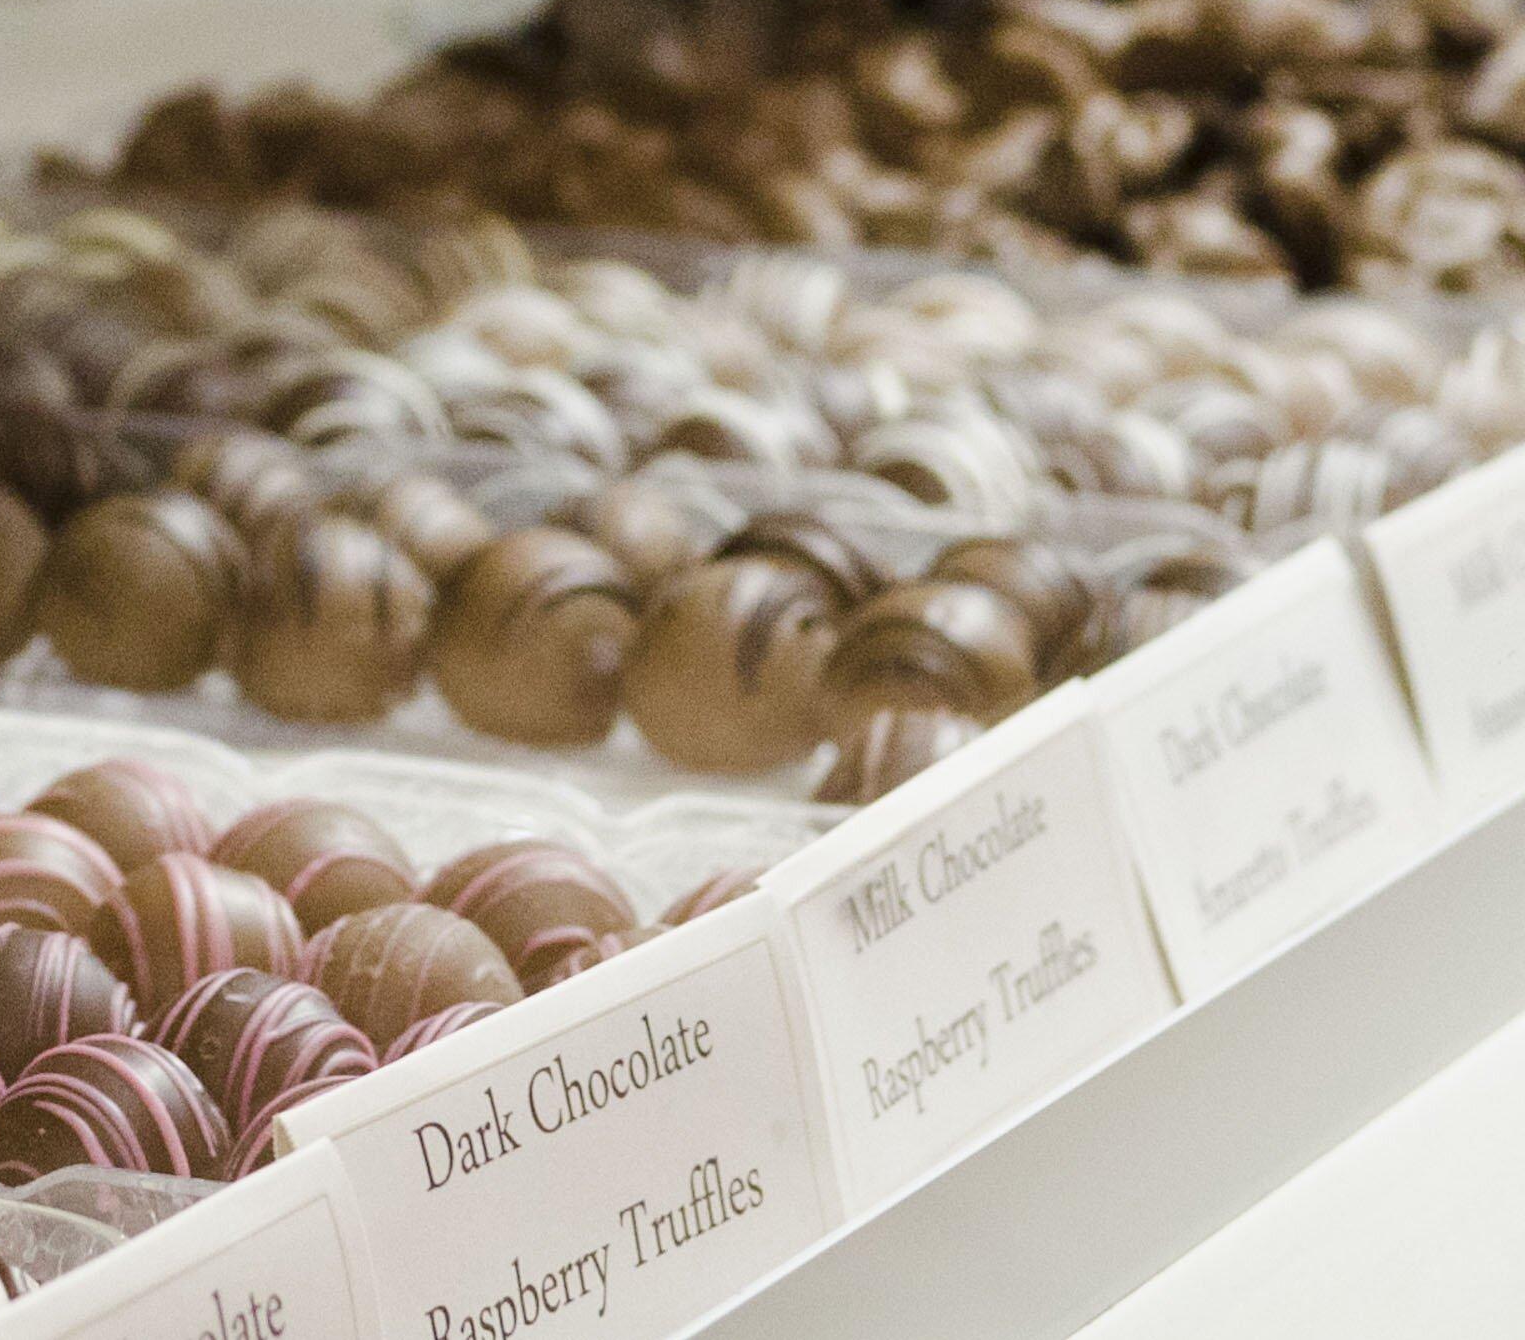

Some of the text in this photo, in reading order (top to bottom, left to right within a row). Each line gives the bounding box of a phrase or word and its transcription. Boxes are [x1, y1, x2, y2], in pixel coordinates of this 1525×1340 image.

[837, 790, 1048, 955] Milk Chocolate
[412, 1015, 714, 1192] Dark Chocolate
[860, 920, 1101, 1120] Raspberry Truffles
[618, 1155, 765, 1269] Truffles
